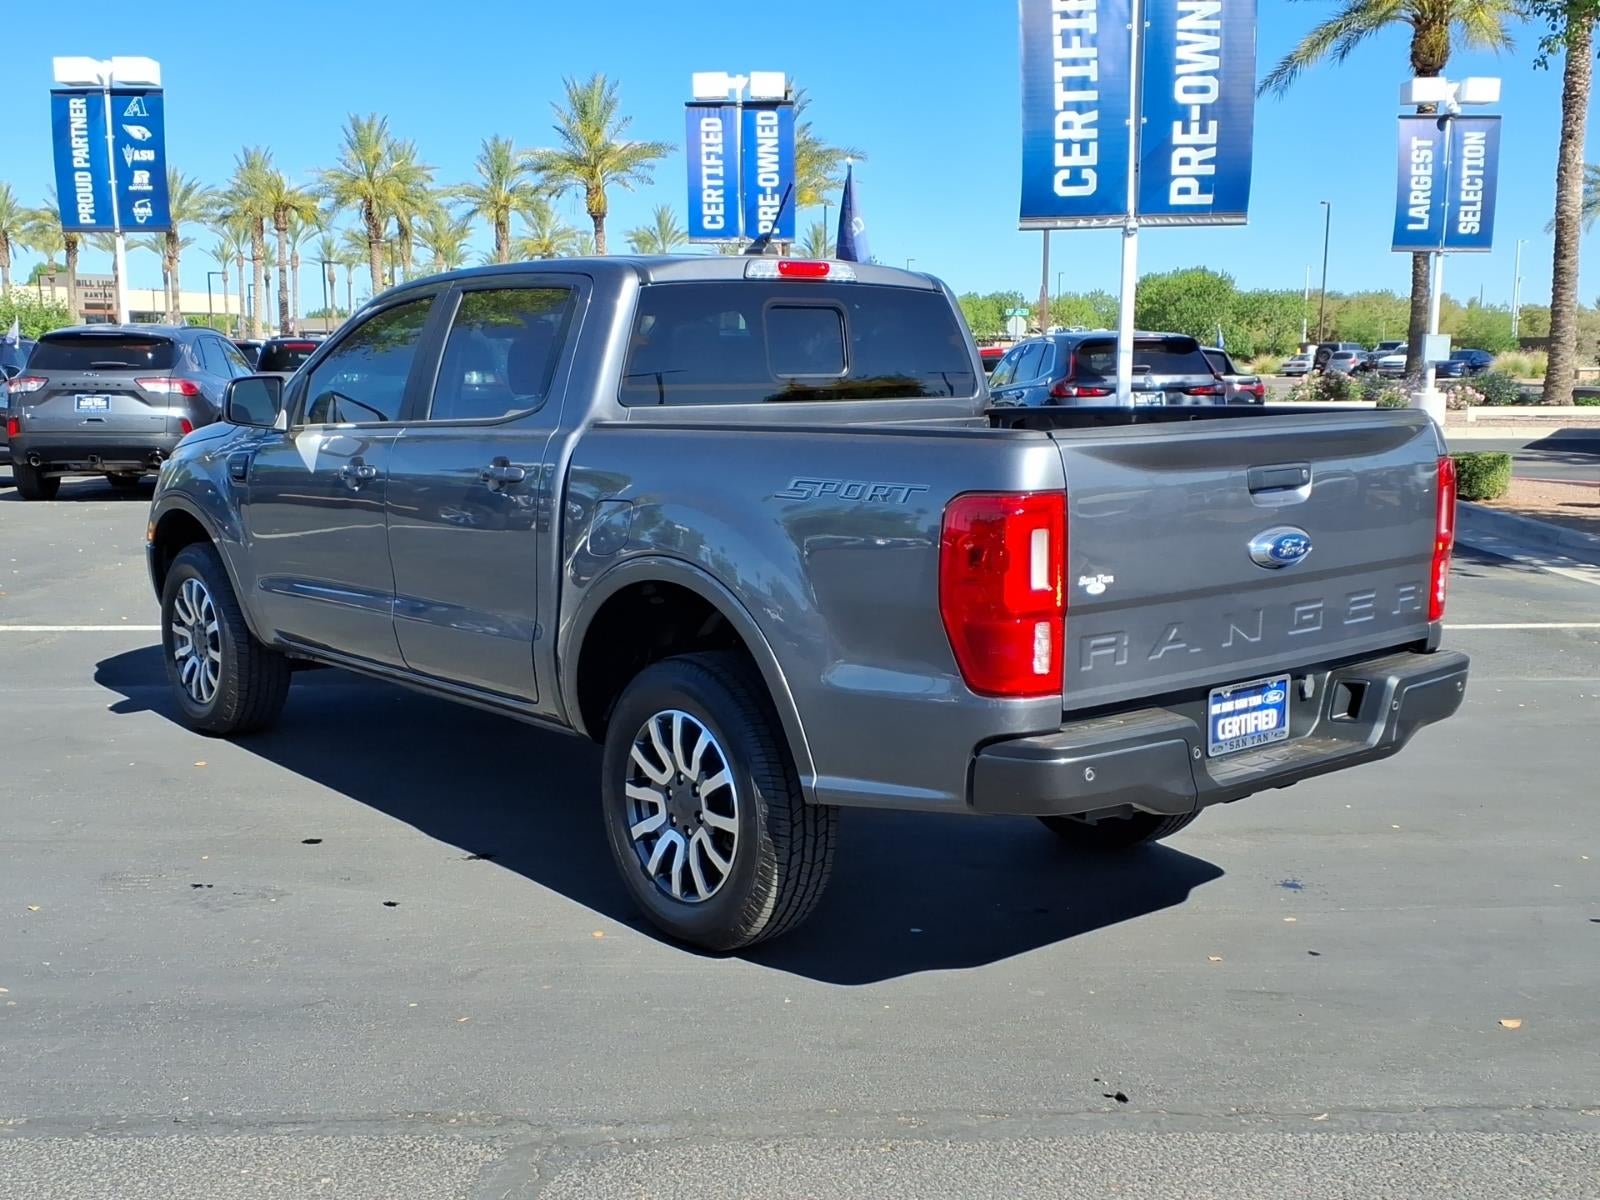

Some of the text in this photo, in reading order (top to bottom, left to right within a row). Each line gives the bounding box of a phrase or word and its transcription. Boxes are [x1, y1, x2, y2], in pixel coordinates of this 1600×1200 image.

[1169, 1, 1222, 206] PRE-OWN
[69, 98, 96, 224] PROUD PARTNER
[133, 150, 155, 161] ASU
[701, 117, 725, 230] CERTIFIED
[756, 111, 780, 234] PRE-OWNED
[1407, 136, 1434, 231] LARGEST
[1458, 131, 1487, 235] SELECTION
[76, 279, 94, 288] BILL
[774, 475, 931, 505] SPORT
[1079, 581, 1422, 672] RANGER
[1217, 708, 1278, 740] CERTIFIED
[1229, 733, 1269, 750] SAN TAN
